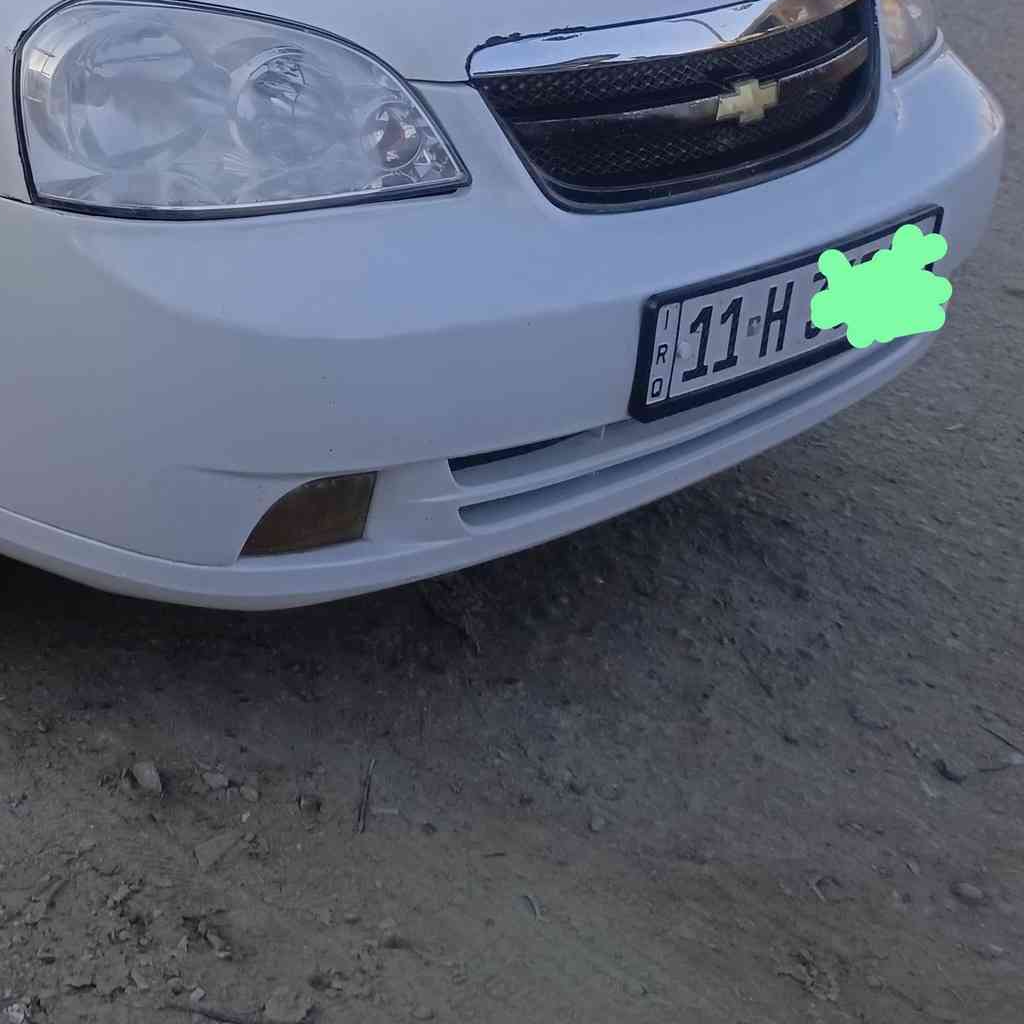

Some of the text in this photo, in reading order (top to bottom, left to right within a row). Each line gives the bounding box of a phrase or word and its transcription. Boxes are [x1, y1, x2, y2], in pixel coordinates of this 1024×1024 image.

[651, 309, 670, 398] IRQ
[681, 296, 743, 382] 11
[758, 281, 794, 358] H
